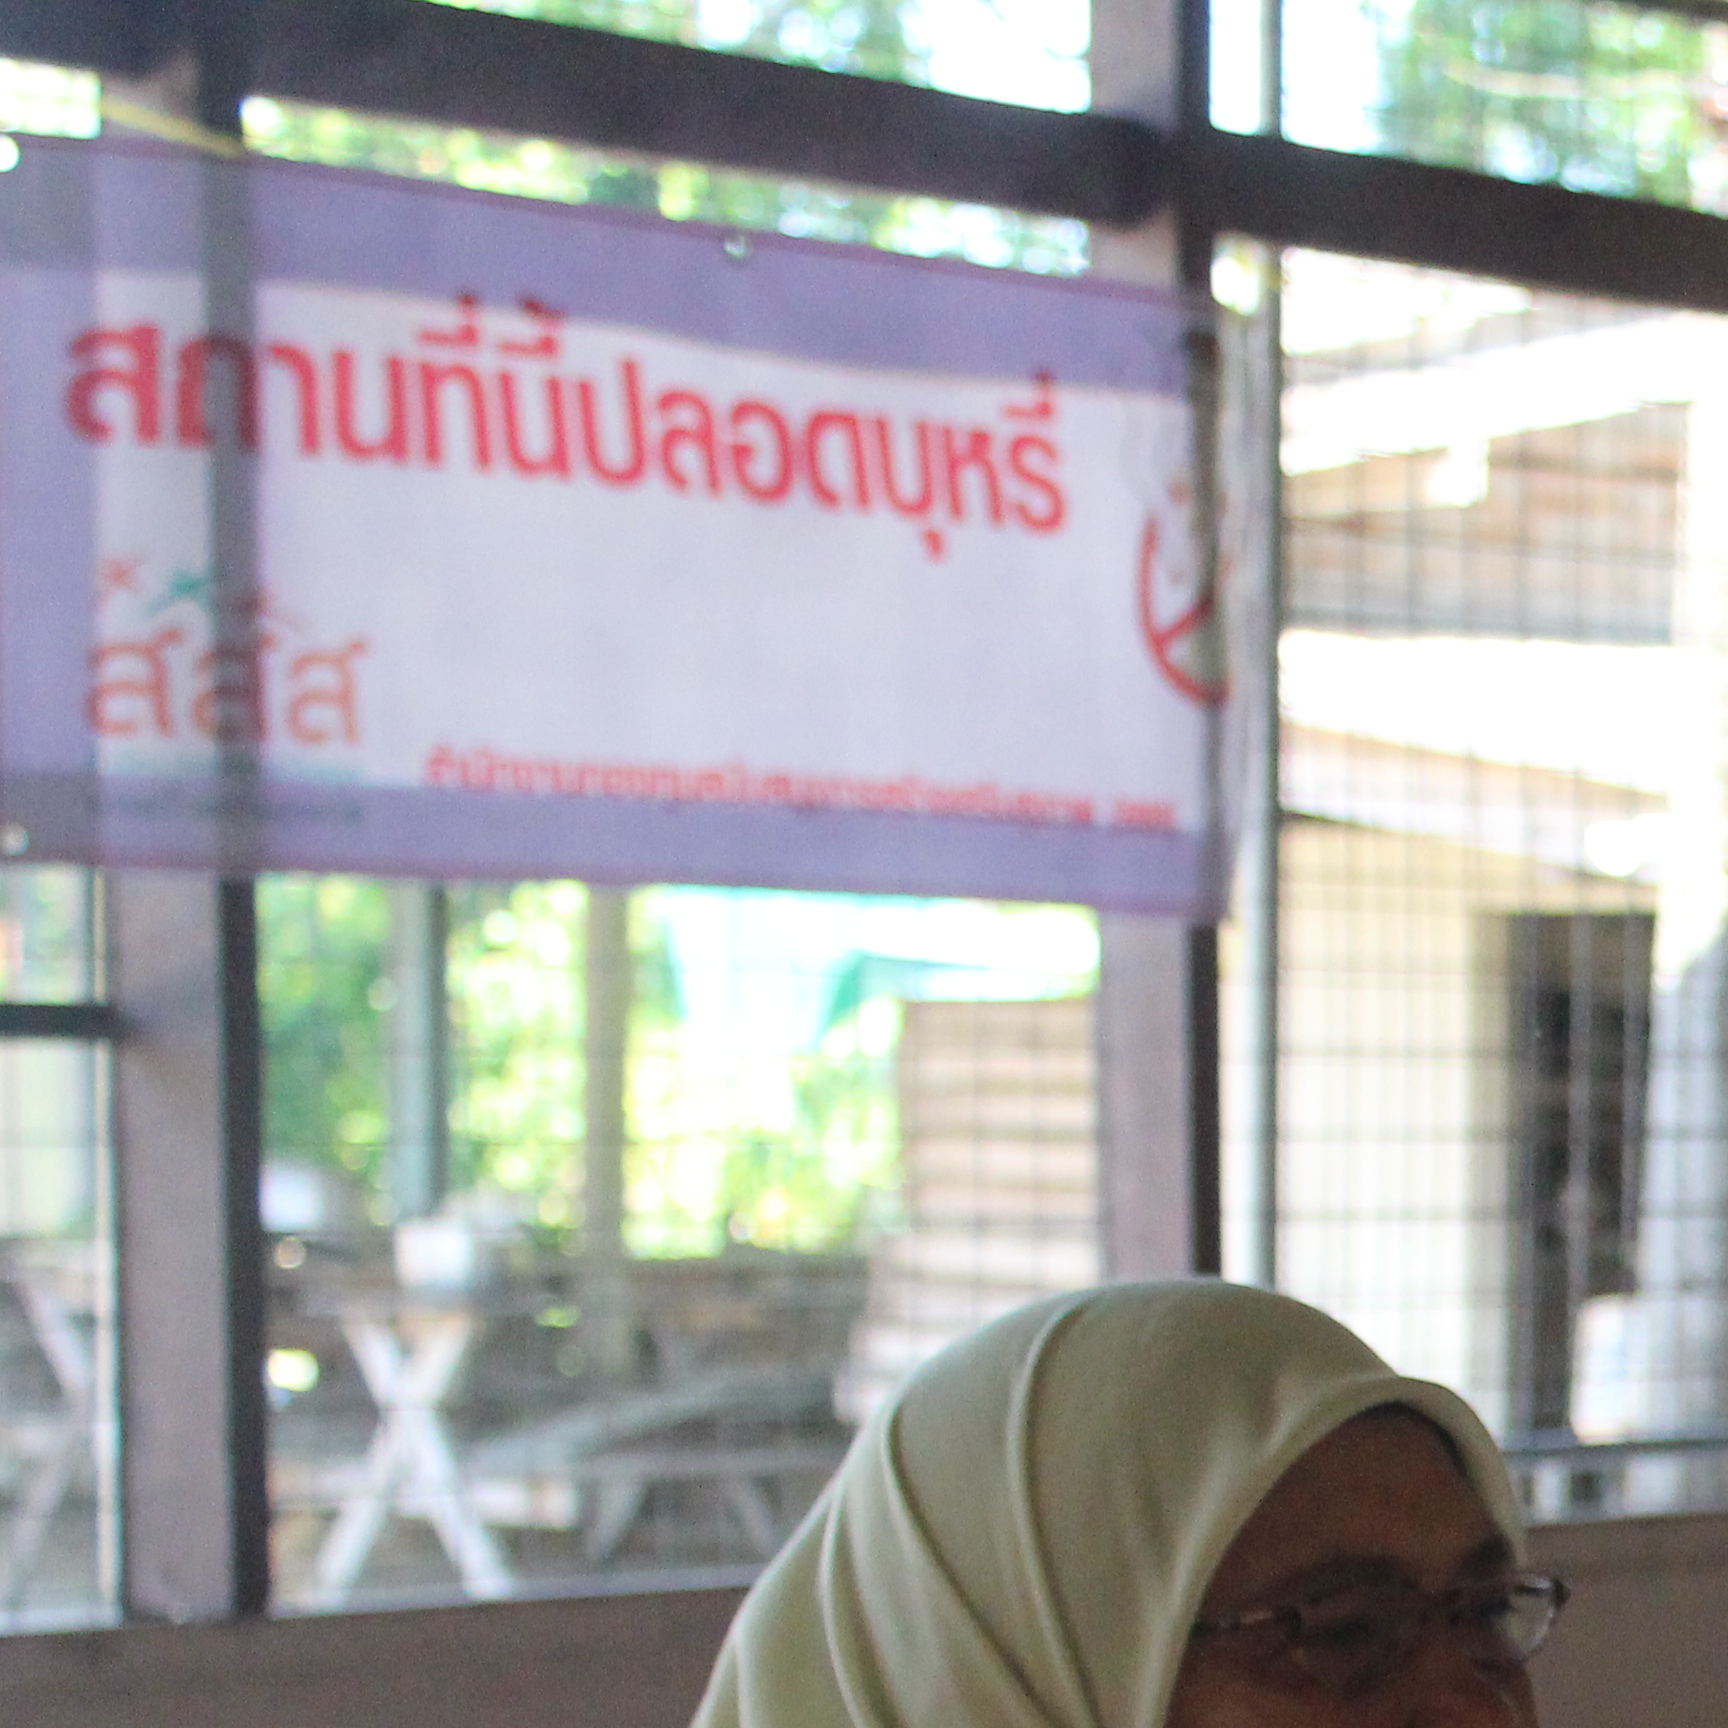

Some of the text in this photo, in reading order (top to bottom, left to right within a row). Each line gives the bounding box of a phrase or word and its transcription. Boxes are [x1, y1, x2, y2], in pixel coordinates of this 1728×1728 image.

[64, 290, 1070, 562] สถานที่นี้ปลอดบุหรี่
